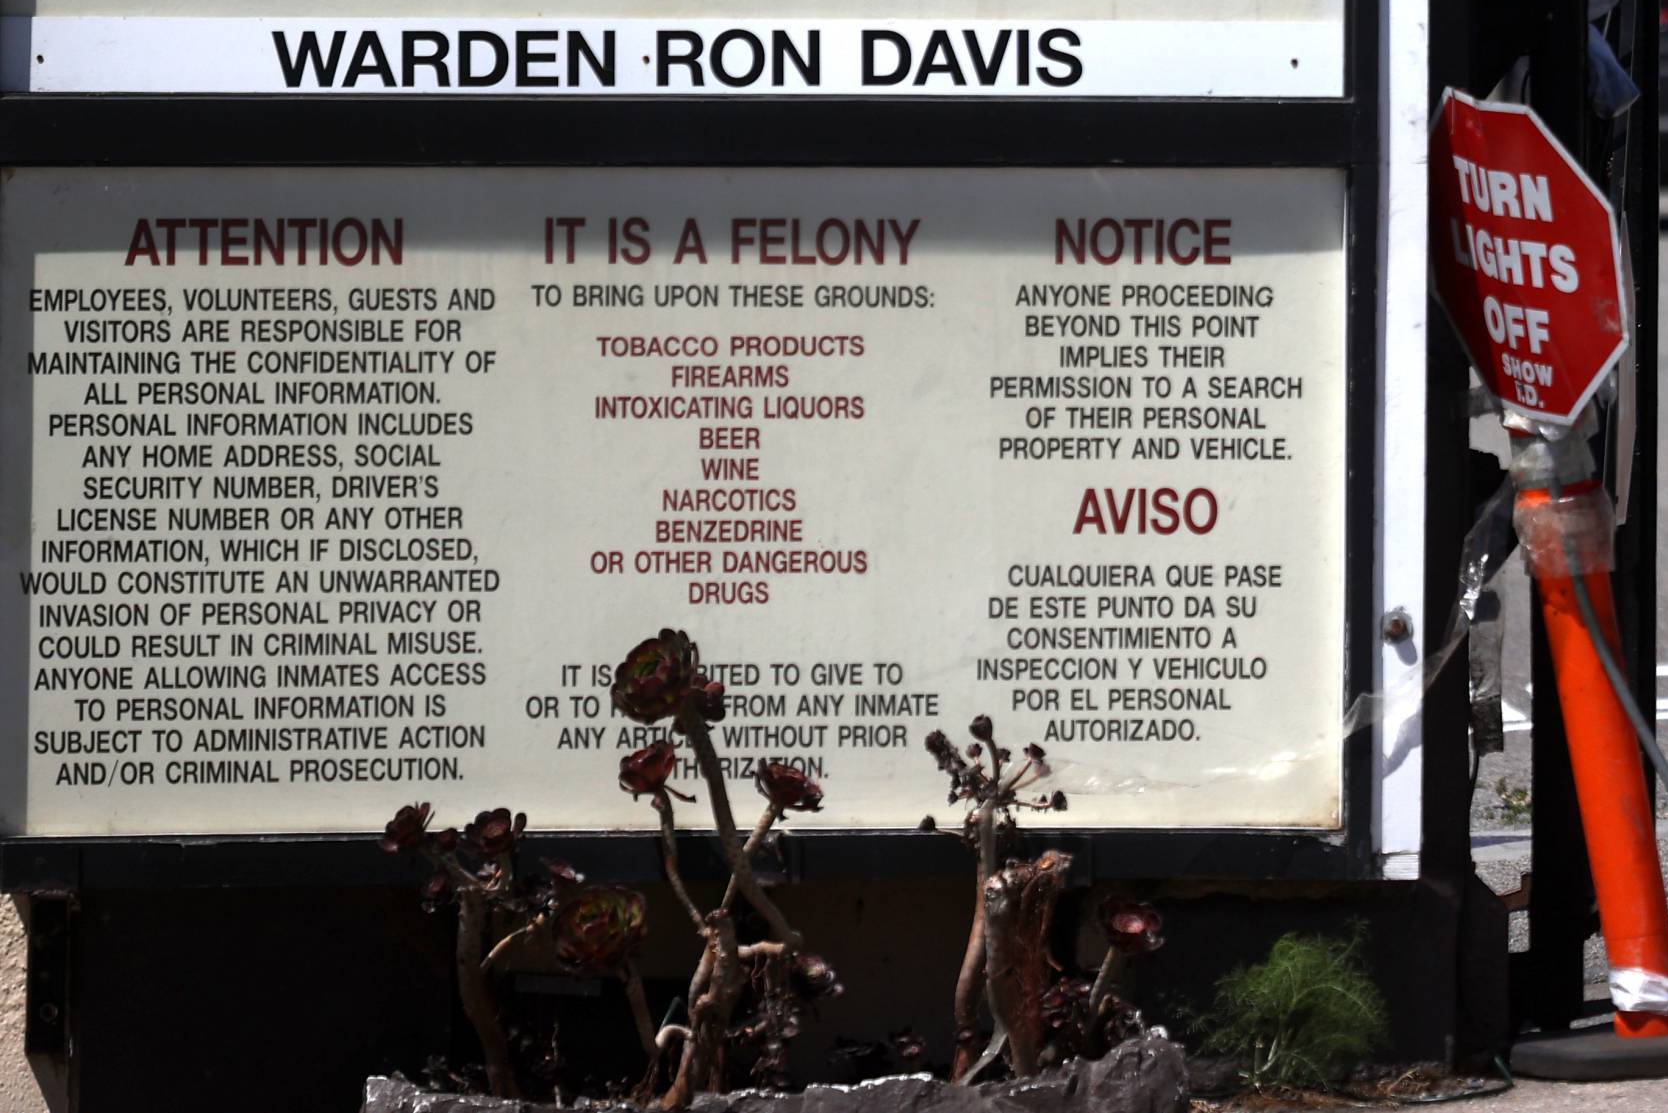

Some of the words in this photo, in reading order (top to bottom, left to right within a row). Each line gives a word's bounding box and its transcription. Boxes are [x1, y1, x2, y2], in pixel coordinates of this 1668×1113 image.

[270, 29, 617, 89] WARDEN
[655, 28, 821, 89] RON
[860, 27, 1084, 88] DAVIS
[1452, 155, 1554, 223] TURN
[123, 216, 404, 267] ATTENTION
[544, 216, 587, 265] IT
[607, 216, 652, 266] IS
[672, 217, 708, 265] A
[731, 217, 921, 267] FELONY
[1054, 216, 1233, 267] NOTICE
[1450, 217, 1580, 294] LIGHTS
[28, 287, 173, 317] EMPLOYEES,
[182, 287, 339, 316] VOLUNTEERS,
[347, 287, 438, 312] GUESTS
[447, 287, 496, 312] AND
[530, 283, 563, 308] TO
[572, 284, 645, 308] BRING
[654, 284, 719, 308] UPON
[727, 284, 804, 308] THESE
[814, 284, 935, 309] GROUNDS:
[1014, 283, 1112, 309] ANYONE
[1121, 283, 1275, 308] PROCEEDING
[63, 318, 172, 344] VISITORS
[181, 319, 230, 343] ARE
[240, 318, 405, 344] RESPONSIBLE
[414, 318, 462, 343] FOR
[1024, 314, 1121, 338] BEYOND
[1129, 314, 1182, 339] THIS
[1191, 314, 1261, 339] POINT
[1483, 296, 1551, 354] OFF
[595, 335, 719, 358] TOBACCO
[729, 335, 865, 357] PRODUCTS
[1059, 344, 1149, 369] IMPLIES
[1157, 344, 1226, 369] THEIR
[27, 350, 181, 376] MAINTAINING
[189, 350, 237, 375] THE
[246, 349, 455, 375] CONFIDENTIALITY
[464, 349, 497, 375] OF
[1502, 352, 1553, 387] SHOW
[671, 364, 790, 389] FIREARMS
[989, 375, 1132, 400] PERMISSION
[1141, 375, 1172, 400] TO
[1181, 375, 1198, 400] A
[1207, 375, 1303, 400] SEARCH
[83, 381, 129, 406] ALL
[137, 380, 266, 406] PERSONAL
[275, 380, 441, 405] INFORMATION.
[1516, 382, 1545, 409] I.D.
[595, 395, 753, 420] INTOXICATING
[763, 395, 865, 420] LIQUORS
[1025, 405, 1057, 430] OF
[1064, 405, 1133, 430] THEIR
[1142, 405, 1267, 430] PERSONAL
[48, 412, 177, 438] PERSONAL
[186, 412, 348, 437] INFORMATION
[357, 411, 474, 437] INCLUDES
[698, 426, 761, 450] BEER
[999, 436, 1123, 461] PROPERTY
[1131, 436, 1181, 460] AND
[1189, 436, 1293, 461] VEHICLE.
[81, 444, 133, 469] ANY
[142, 444, 213, 469] HOME
[222, 443, 344, 472] ADDRESS,
[353, 443, 442, 468] SOCIAL
[700, 457, 760, 481] WINE
[82, 475, 204, 501] SECURITY
[213, 475, 321, 504] NUMBER,
[331, 474, 439, 499] DRIVER'S
[662, 488, 797, 513] NARCOTICS
[56, 507, 158, 533] LICENSE
[167, 507, 270, 532] NUMBER
[280, 506, 315, 532] OR
[324, 506, 375, 531] ANY
[384, 506, 463, 531] OTHER
[1072, 486, 1220, 536] AVISO
[655, 519, 803, 544] BENZEDRINE
[41, 538, 210, 568] INFORMATION,
[219, 538, 299, 563] WHICH
[309, 538, 330, 562] IF
[339, 537, 479, 566] DISCLOSED,
[590, 550, 624, 575] OR
[634, 550, 713, 575] OTHER
[722, 549, 868, 575] DANGEROUS
[19, 570, 107, 596] WOULD
[117, 570, 265, 595] CONSTITUTE
[274, 569, 309, 594] AN
[319, 569, 501, 594] UNWARRANTED
[1007, 563, 1156, 588] CUALQUIERA
[1165, 564, 1214, 588] QUE
[1224, 564, 1283, 589] PASE
[688, 580, 770, 605] DRUGS
[39, 602, 150, 629] INVASION
[159, 602, 192, 627] OF
[201, 600, 330, 626] PERSONAL
[338, 599, 438, 625] PRIVACY
[447, 599, 482, 624] OR
[988, 596, 1019, 620] DE
[1029, 595, 1087, 620] ESTE
[1097, 594, 1175, 620] PUNTO
[1184, 595, 1216, 619] DA
[1225, 595, 1257, 619] SU
[38, 635, 121, 660] COULD
[131, 633, 222, 659] RESULT
[230, 633, 254, 658] IN
[263, 631, 378, 657] CRIMINAL
[387, 630, 483, 656] MISUSE.
[1006, 625, 1212, 651] CONSENTIMIENTO
[1220, 626, 1238, 649] A
[33, 666, 134, 692] ANYONE
[143, 664, 267, 690] ALLOWING
[277, 662, 380, 689] INMATES
[389, 661, 487, 687] ACCESS
[976, 656, 1118, 682] INSPECCION
[1127, 657, 1144, 681] Y
[1152, 656, 1268, 681] VEHICULO
[73, 697, 106, 723] TO
[116, 696, 245, 722] PERSONAL
[253, 693, 415, 721] INFORMATION
[424, 693, 447, 718] IS
[795, 693, 845, 717] ANY
[854, 693, 939, 717] INMATE
[1012, 687, 1060, 712] POR
[1070, 688, 1099, 712] EL
[1108, 687, 1232, 712] PERSONAL
[33, 729, 143, 755] SUBJECT
[151, 728, 184, 754] TO
[192, 725, 389, 753] ADMINISTRATIVE
[398, 724, 486, 750] ACTION
[721, 724, 829, 749] WITHOUT
[837, 724, 908, 749] PRIOR
[1043, 718, 1201, 743] AUTORIZADO.
[55, 759, 155, 788] AND/OR
[165, 759, 281, 785] CRIMINAL
[289, 756, 464, 783] PROSECUTION.
